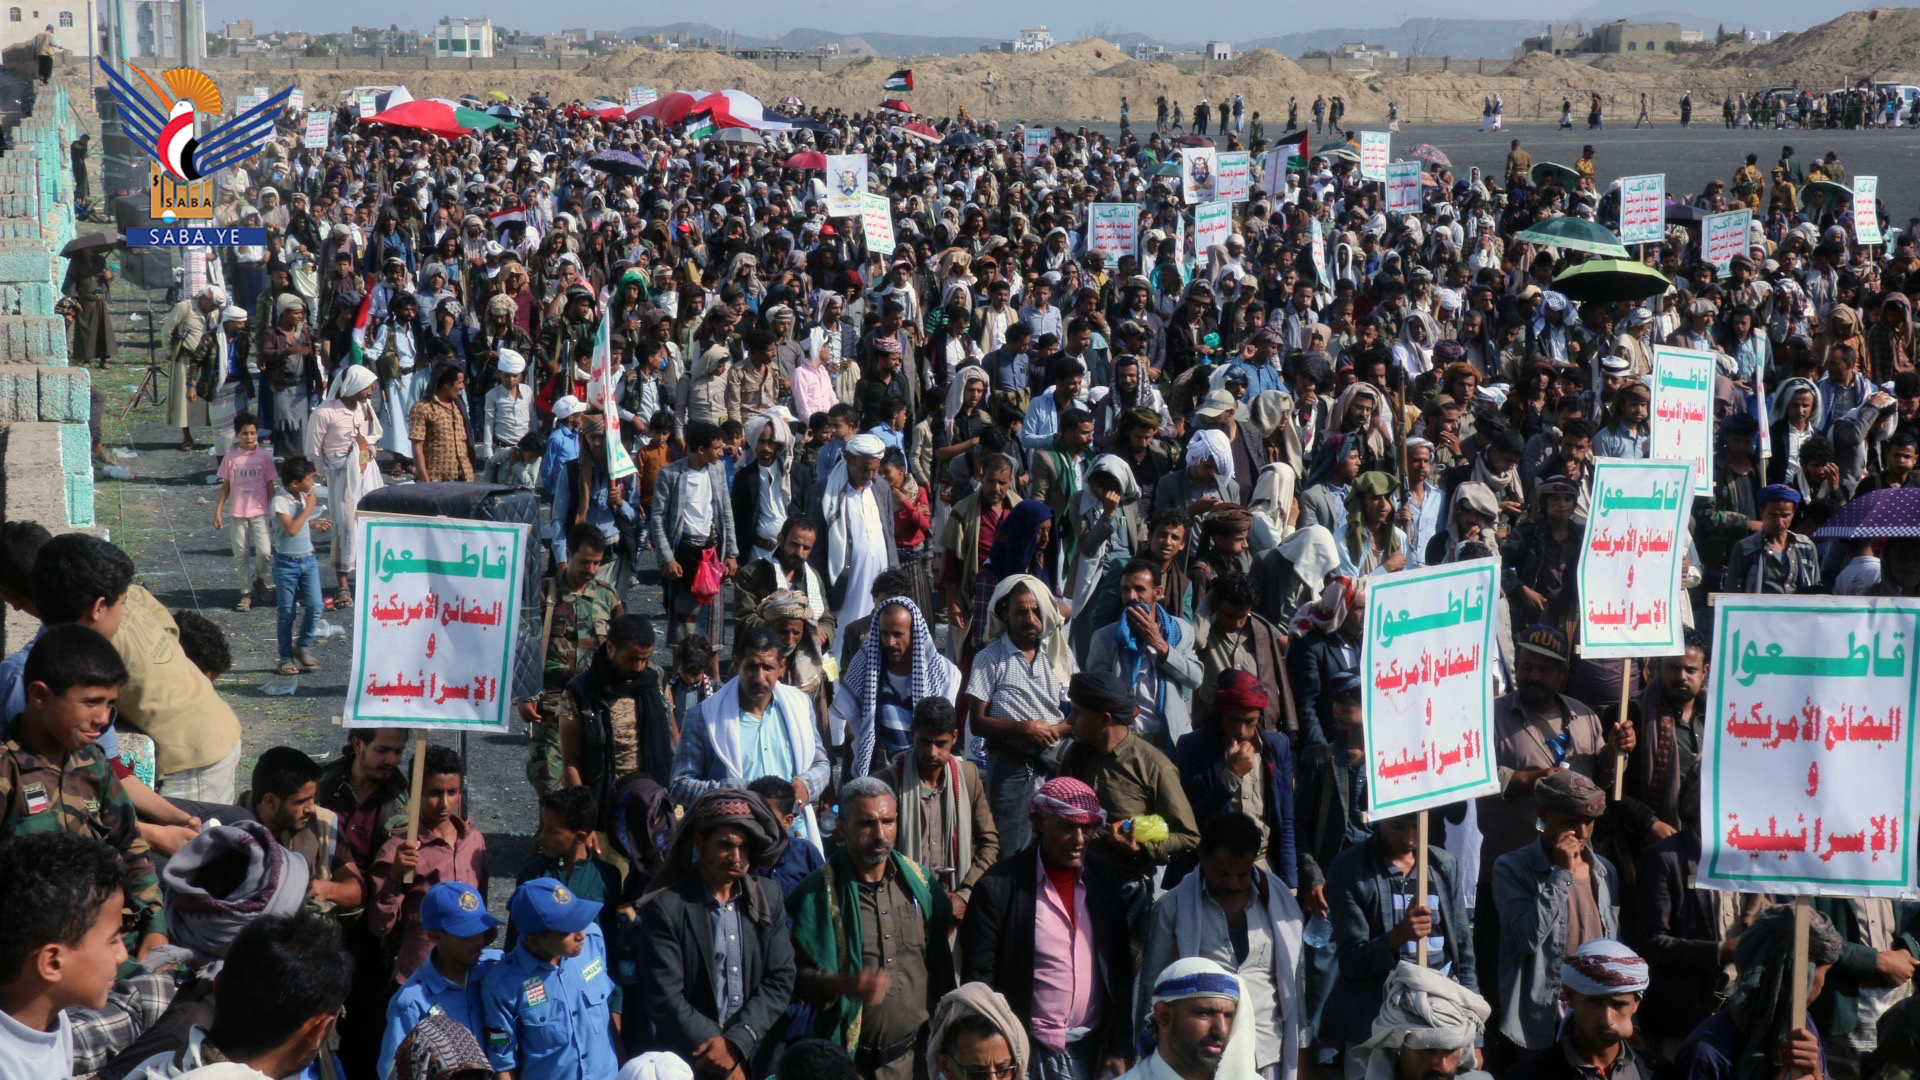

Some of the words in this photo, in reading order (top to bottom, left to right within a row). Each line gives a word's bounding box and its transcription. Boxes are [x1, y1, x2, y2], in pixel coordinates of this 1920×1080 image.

[1096, 207, 1118, 220] أكبر
[1119, 208, 1134, 218] الله
[1658, 363, 1708, 392] قاطعوا
[1656, 398, 1682, 423] الأمريكية
[1682, 402, 1706, 424] البضائع
[1676, 429, 1681, 446] و
[1599, 480, 1680, 517] قاطعوا
[1591, 522, 1638, 558] الأمريكية
[1637, 528, 1673, 558] البضائع
[375, 540, 507, 583] قاطعوا
[1626, 564, 1634, 588] و
[371, 587, 440, 627] الأمريكية
[441, 594, 503, 631] البضائع
[1376, 584, 1484, 648] قاطعوا
[1588, 598, 1668, 631] الإسرائيلية
[426, 632, 436, 658] و
[1732, 628, 1906, 688] قاطعوا
[1374, 646, 1432, 696] الأمريكية
[1434, 642, 1480, 687] البضائع
[366, 669, 497, 707] الإسرائيلية
[1424, 698, 1432, 726] و
[1726, 696, 1822, 750] الأمريكية
[1824, 702, 1901, 752] البضائع
[1378, 728, 1481, 785] الإسرائيلية
[1806, 761, 1820, 798] و
[1726, 812, 1899, 862] الإسرائيلية
